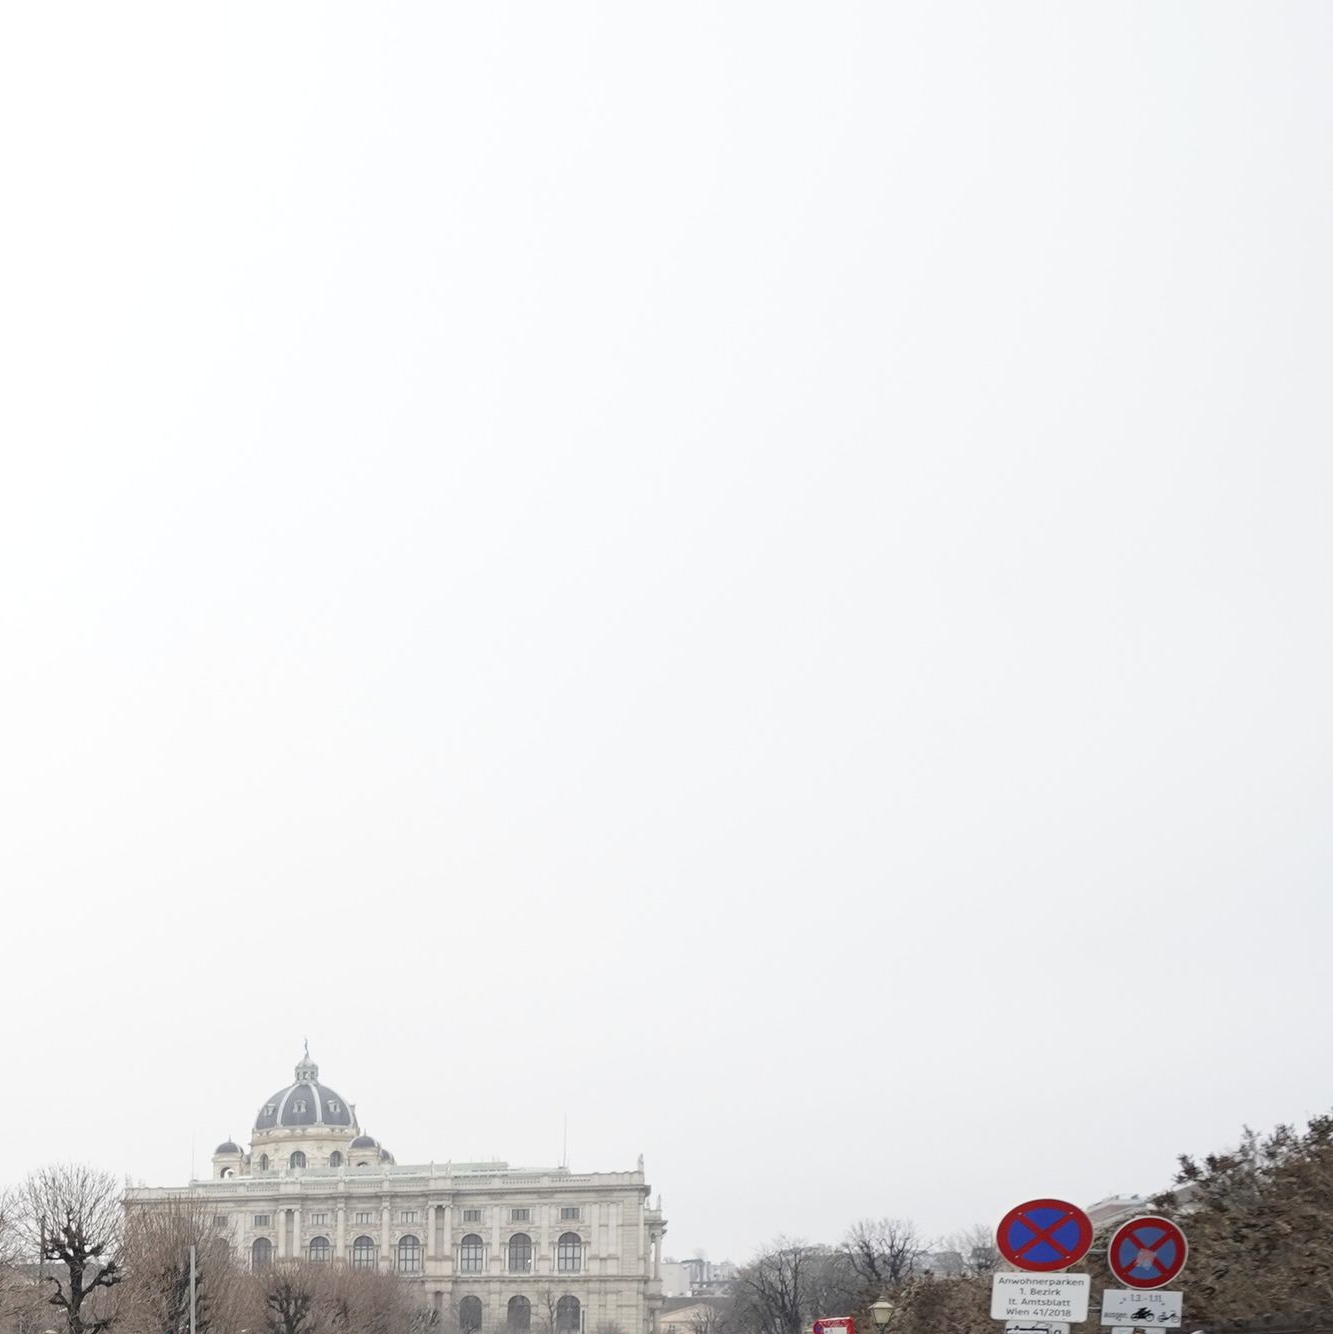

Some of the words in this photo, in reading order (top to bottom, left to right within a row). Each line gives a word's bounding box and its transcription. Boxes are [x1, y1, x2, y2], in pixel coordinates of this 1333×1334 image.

[997, 1277, 1085, 1286] Anwohnerparken
[1030, 1288, 1061, 1296] Bezirk
[1021, 1298, 1071, 1307] Amtsblatt
[1006, 1308, 1030, 1316] Wien
